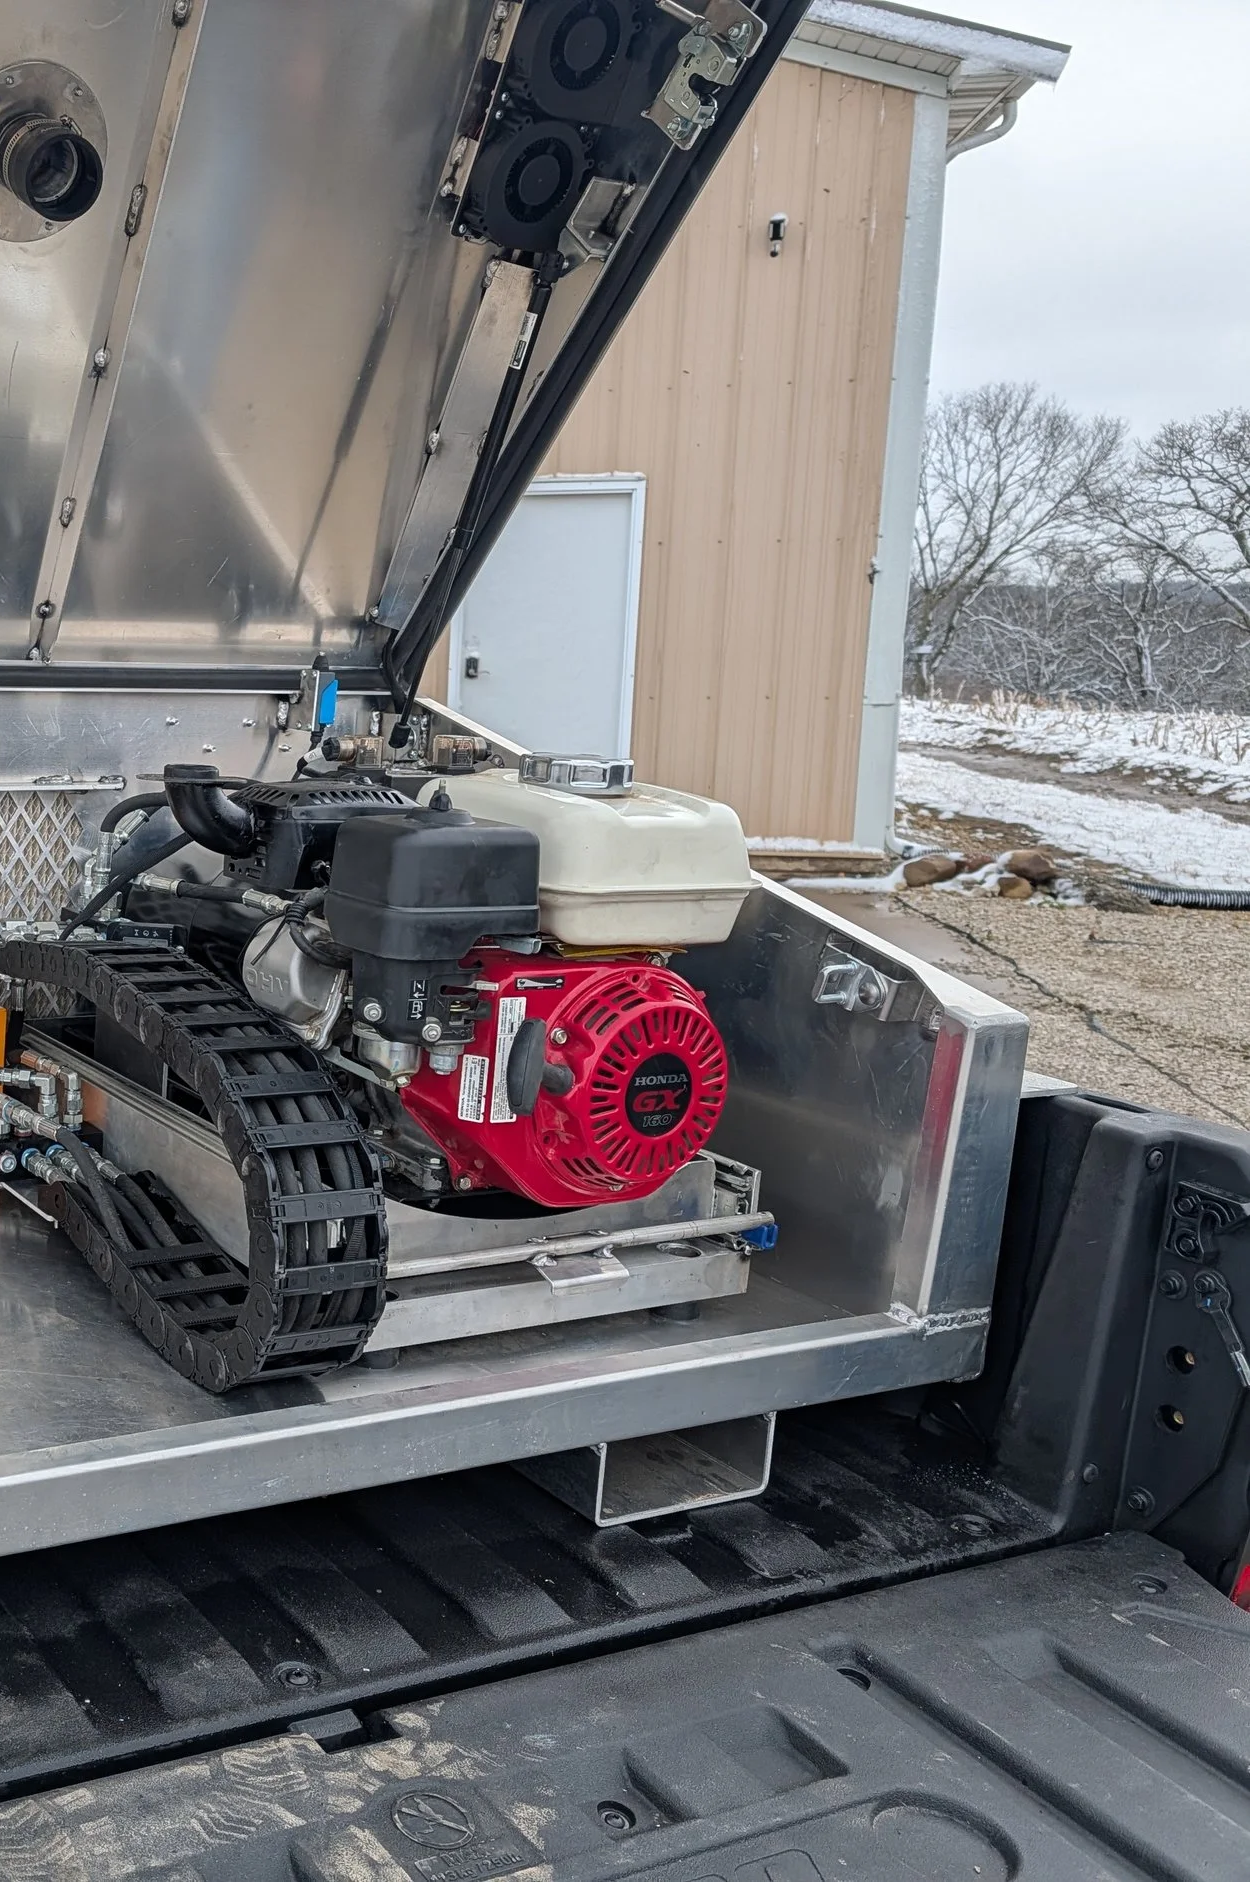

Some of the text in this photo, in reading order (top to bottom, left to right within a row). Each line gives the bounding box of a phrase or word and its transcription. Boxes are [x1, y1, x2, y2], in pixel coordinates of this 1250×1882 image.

[634, 1073, 689, 1086] HONDA
[632, 1086, 685, 1113] GX
[642, 1113, 673, 1128] 160
